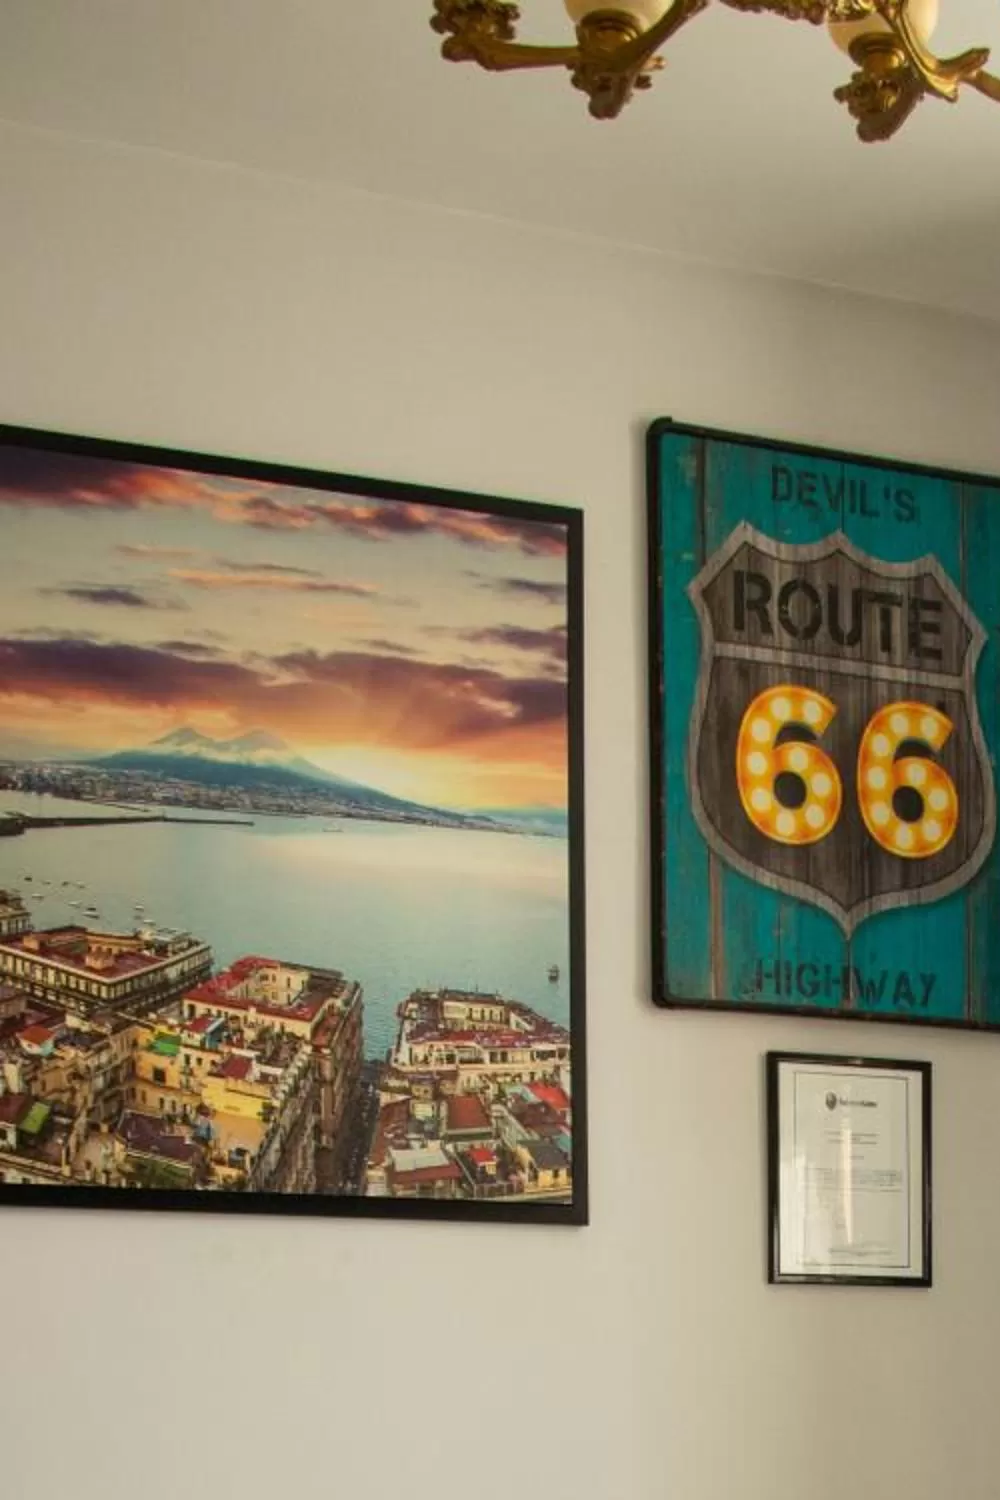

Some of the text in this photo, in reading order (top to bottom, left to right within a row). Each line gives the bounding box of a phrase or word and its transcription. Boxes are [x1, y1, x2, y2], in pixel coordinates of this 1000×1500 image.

[771, 464, 917, 522] DEVIL'S
[733, 569, 944, 662] ROUTE
[736, 684, 959, 859] 66
[754, 959, 938, 1008] HIGHWAY
